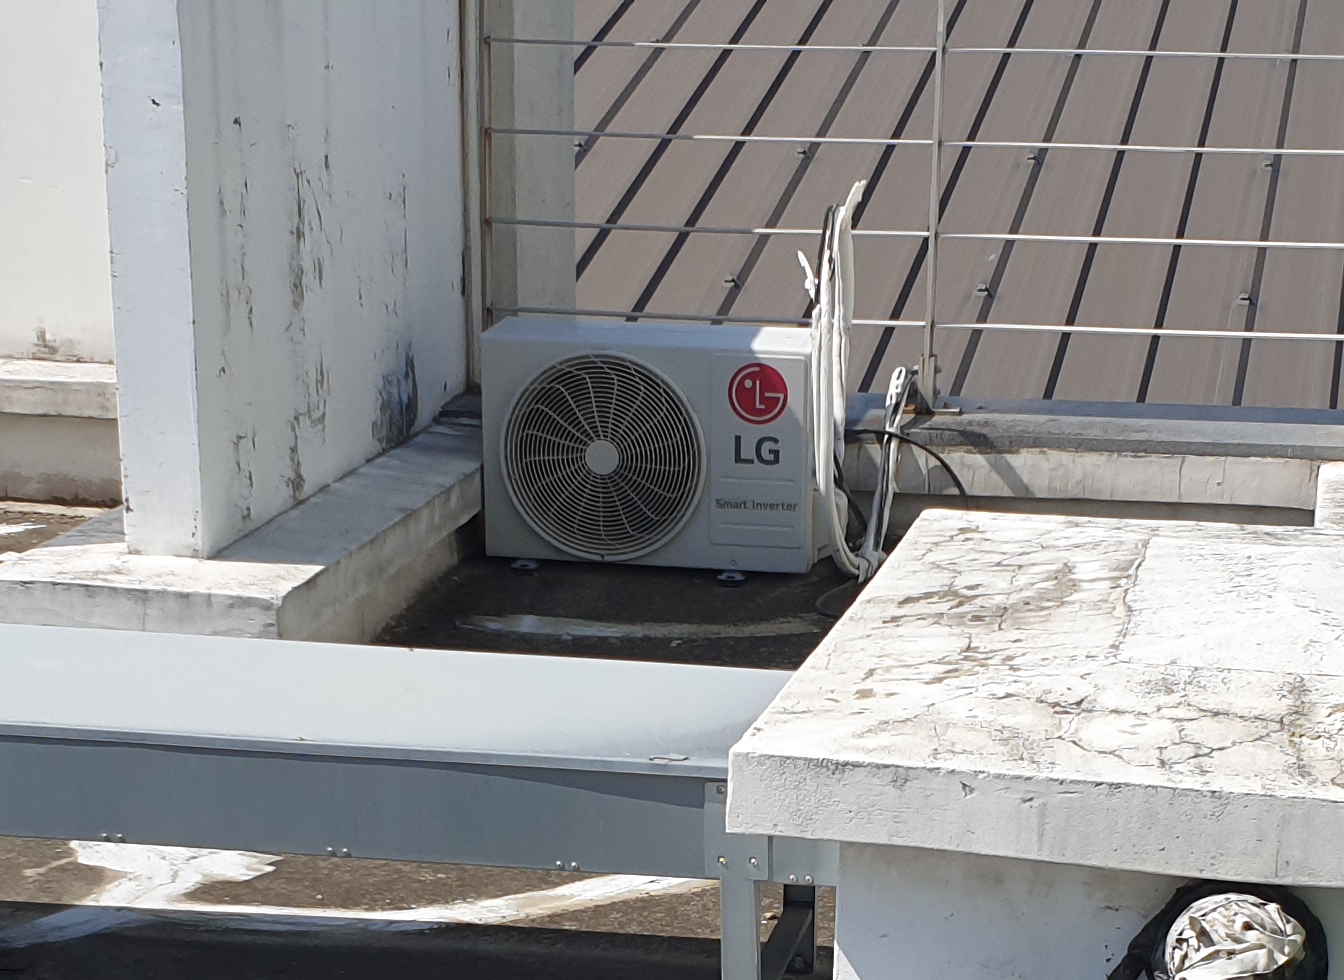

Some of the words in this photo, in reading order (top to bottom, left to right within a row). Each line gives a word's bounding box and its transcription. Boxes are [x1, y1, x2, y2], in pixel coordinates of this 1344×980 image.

[734, 434, 780, 467] LG
[715, 498, 748, 511] Smart
[752, 500, 798, 512] Inverter
